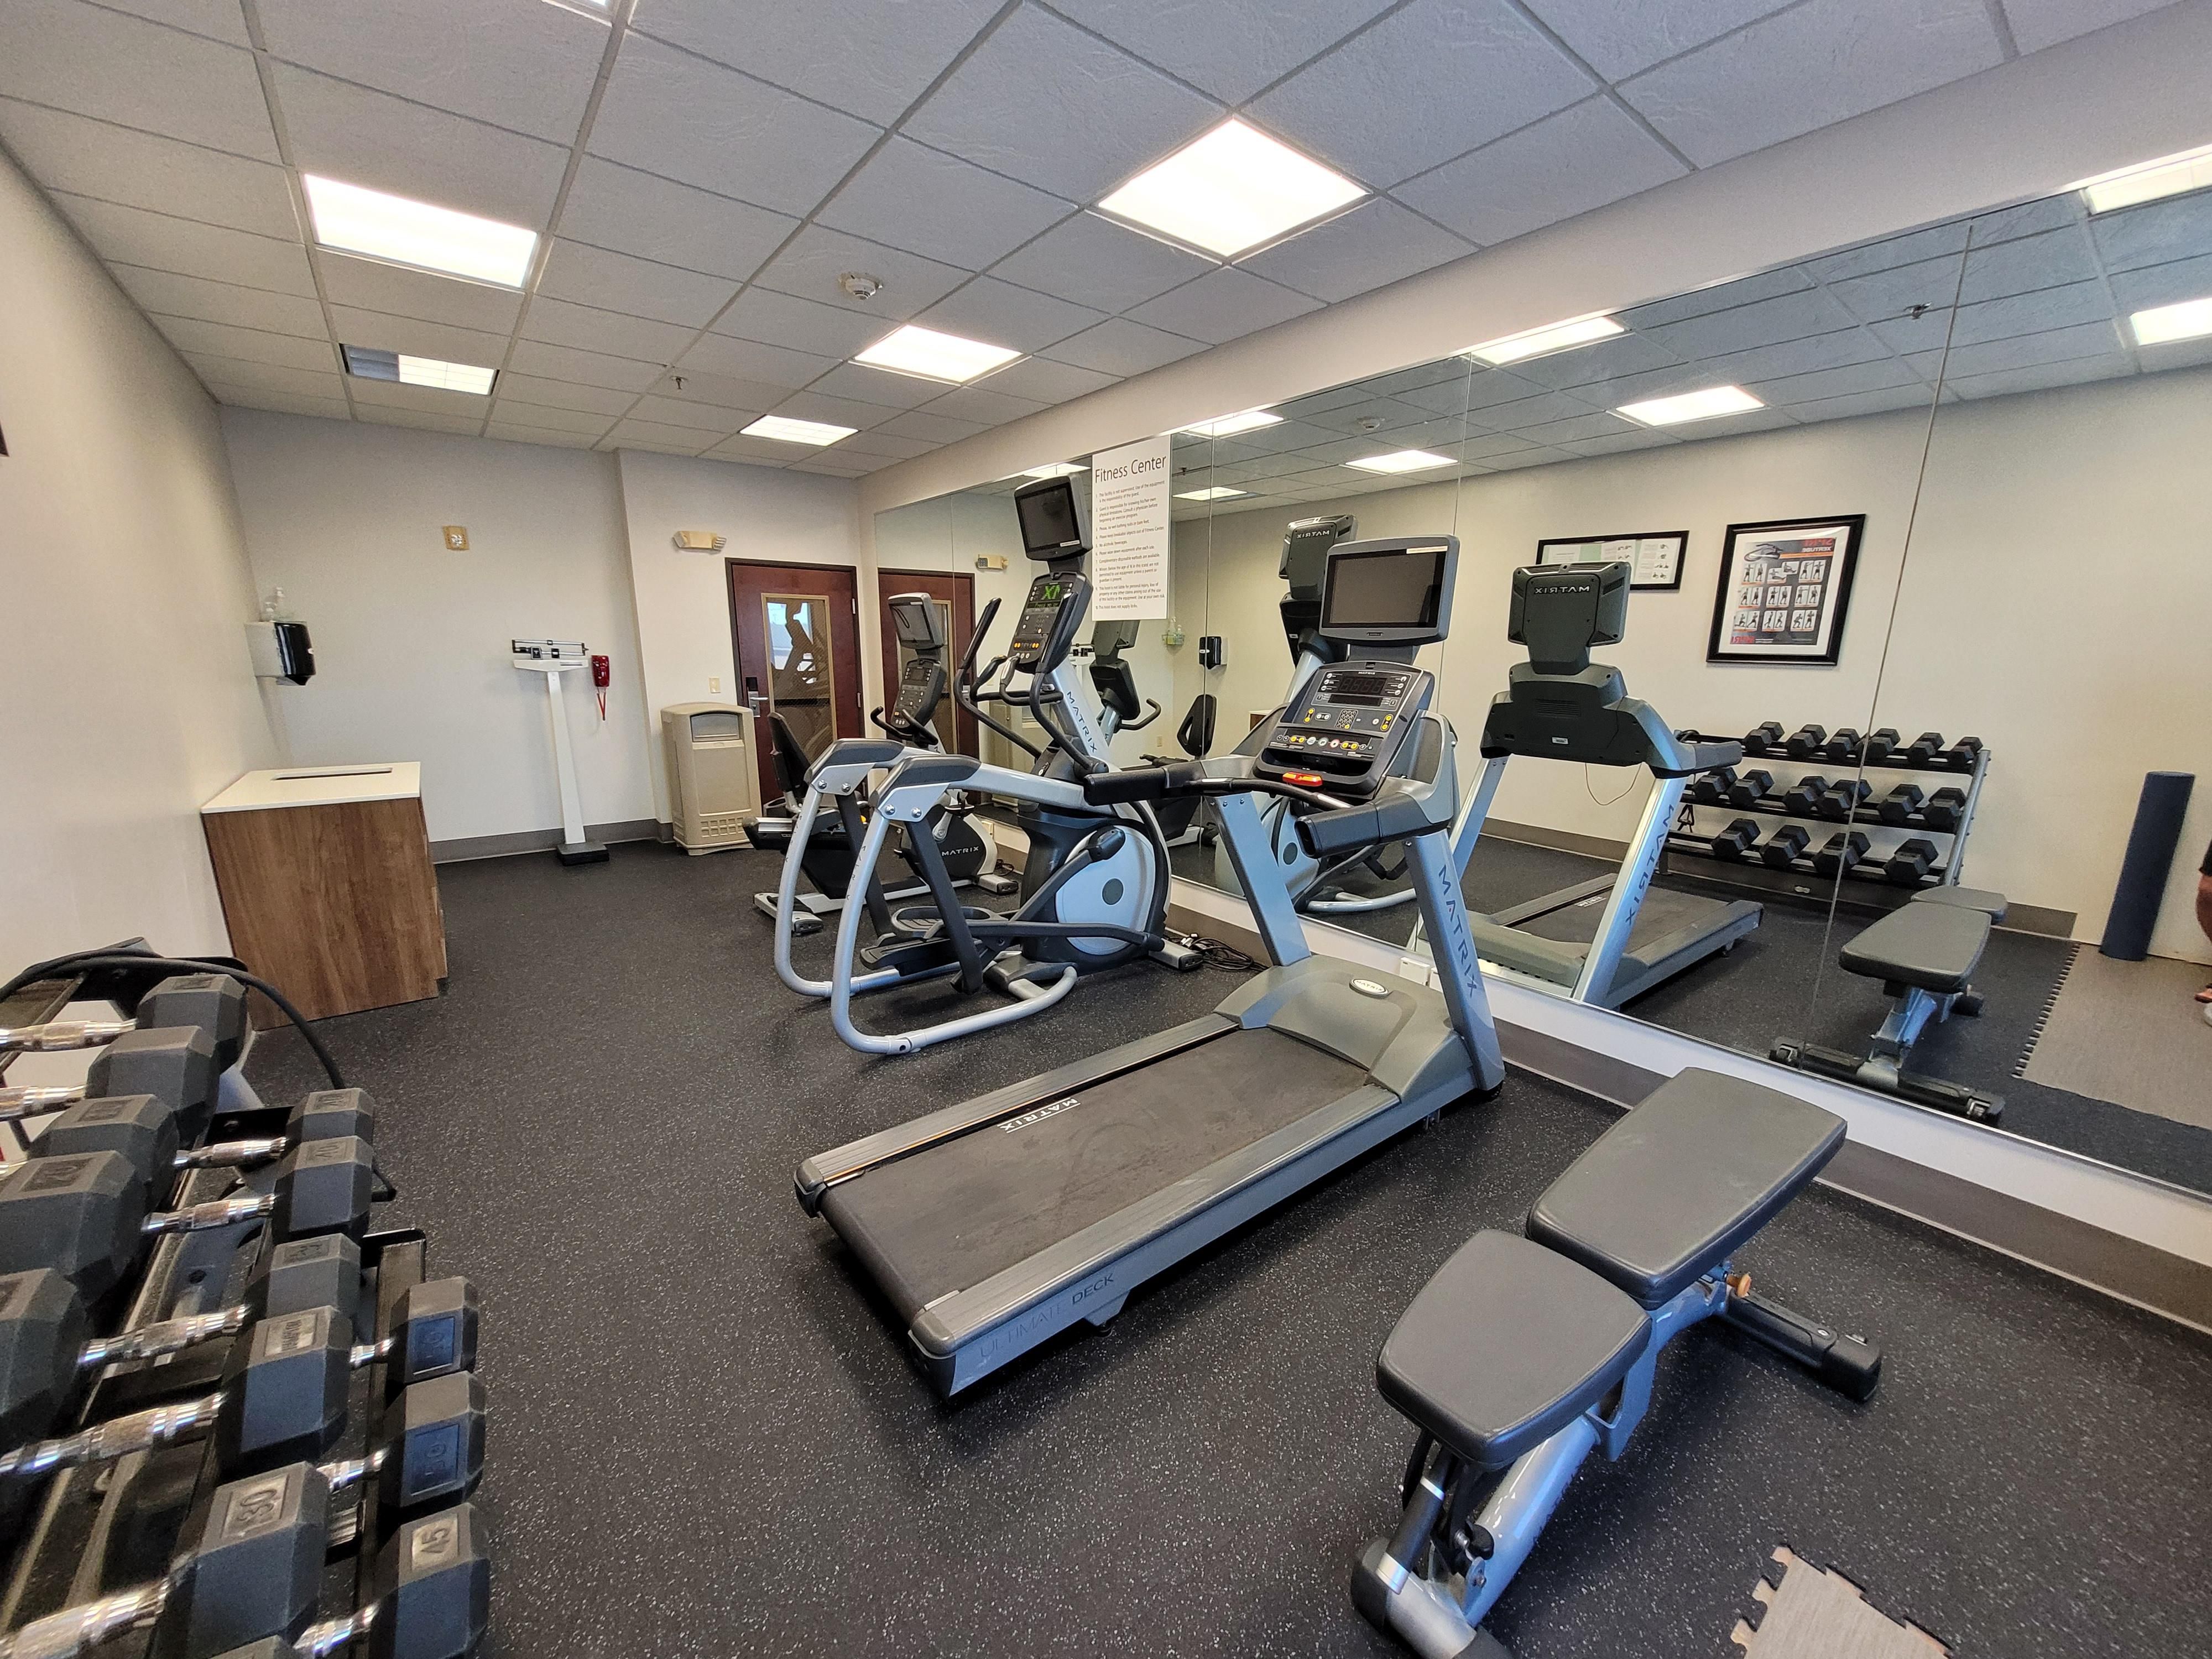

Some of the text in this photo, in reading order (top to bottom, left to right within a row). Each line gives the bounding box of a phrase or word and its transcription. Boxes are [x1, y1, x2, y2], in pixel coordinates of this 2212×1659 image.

[1095, 456, 1166, 483] Fitness Center
[1066, 691, 1098, 753] MATRIX
[941, 846, 979, 857] MATRIX
[1438, 864, 1477, 998] MATRIX
[1357, 980, 1383, 992] MATRIX
[1000, 1099, 1078, 1130] MATRIX
[1072, 1272, 1114, 1305] DECK
[420, 1528, 450, 1554] 45
